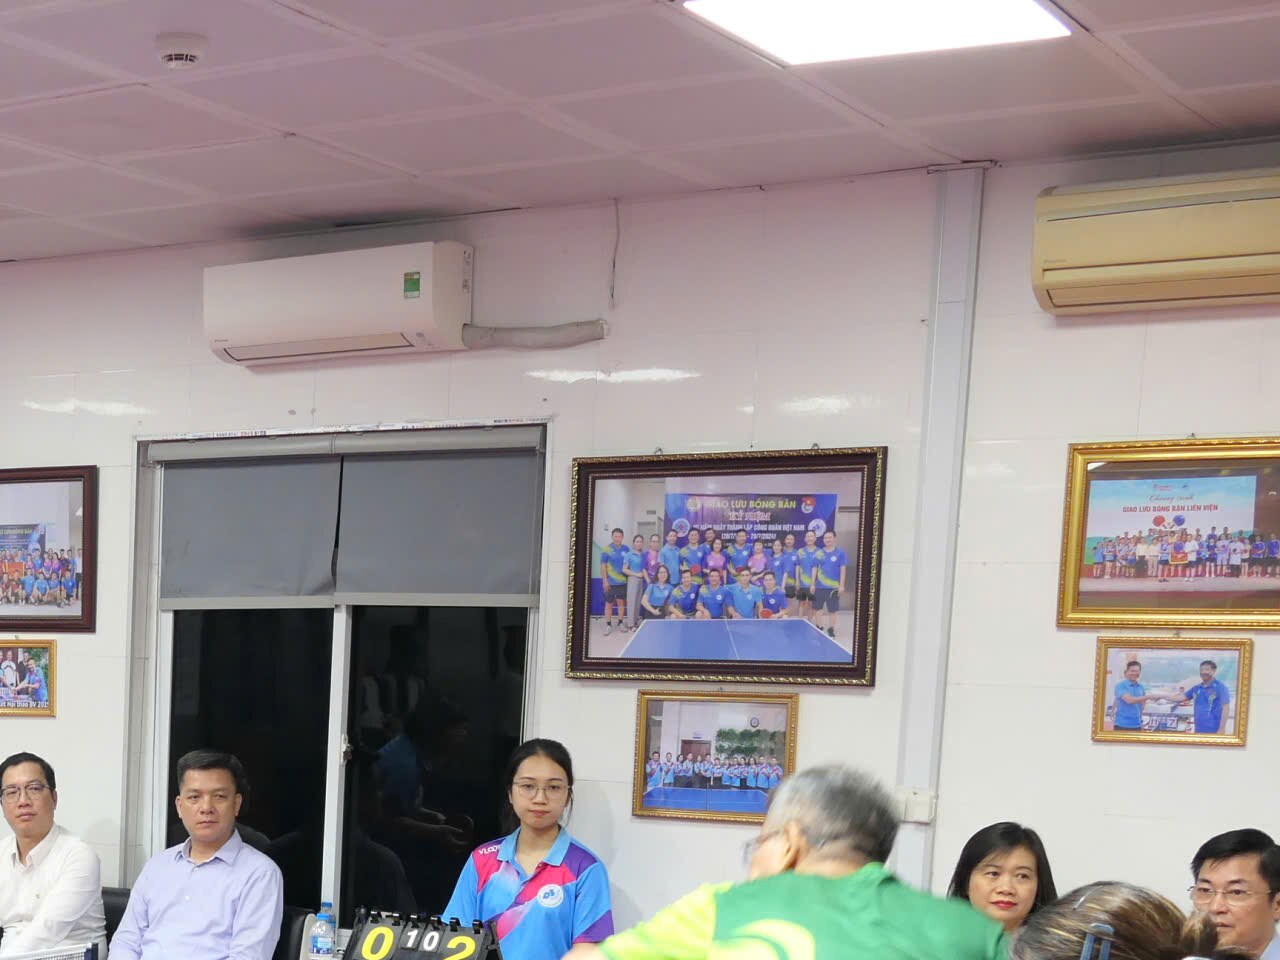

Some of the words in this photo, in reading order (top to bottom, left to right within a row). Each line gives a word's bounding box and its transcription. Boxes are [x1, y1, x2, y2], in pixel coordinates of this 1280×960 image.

[361, 926, 394, 960] 0
[406, 929, 420, 948] 1
[423, 931, 439, 951] 0
